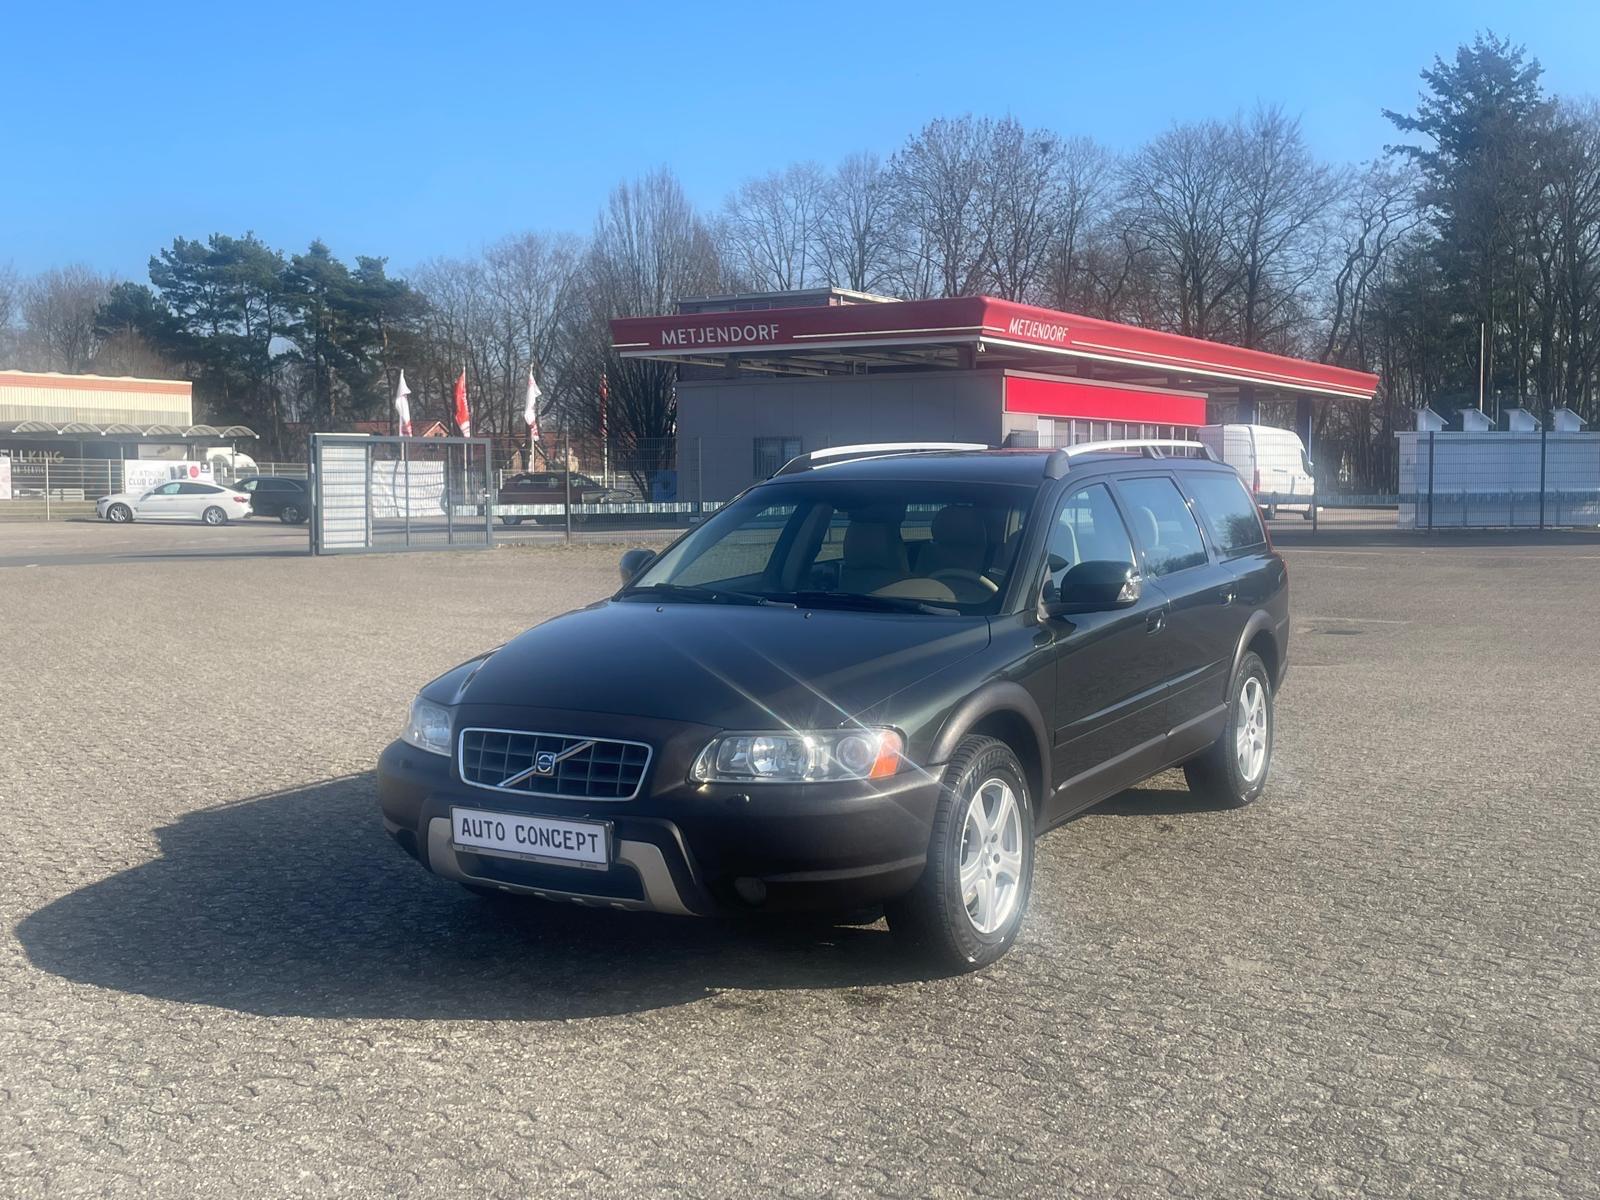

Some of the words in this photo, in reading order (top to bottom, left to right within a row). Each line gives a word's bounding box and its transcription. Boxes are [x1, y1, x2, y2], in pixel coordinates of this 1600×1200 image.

[661, 324, 779, 345] METJENDORF
[1008, 317, 1069, 342] METJENDORF
[461, 817, 506, 841] AUTO
[515, 825, 598, 853] CONCEPT
